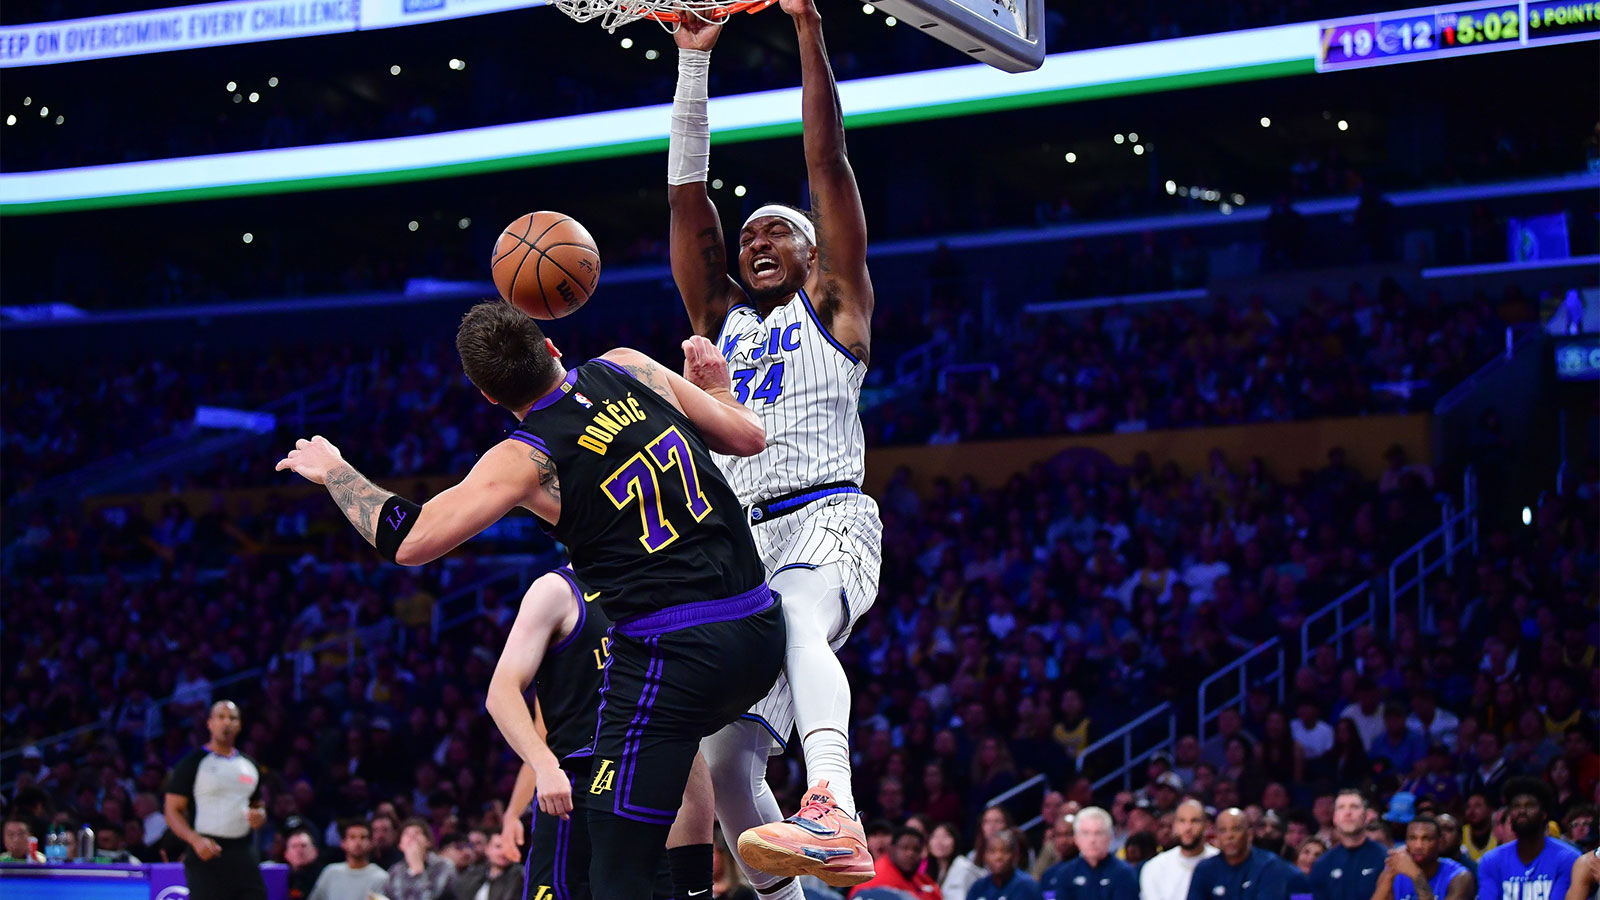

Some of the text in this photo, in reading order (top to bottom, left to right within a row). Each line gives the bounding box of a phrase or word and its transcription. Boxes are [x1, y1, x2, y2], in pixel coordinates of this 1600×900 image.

[35, 29, 60, 56] ON
[65, 15, 183, 53] OVERCOMING
[188, 10, 247, 39] EVERY
[1398, 20, 1433, 51] 12
[1457, 9, 1519, 44] 5:02
[1529, 9, 1541, 28] 3
[1338, 28, 1373, 58] 19
[732, 360, 785, 405] 34
[577, 391, 647, 456] DONČIĆ
[600, 424, 713, 554] 77
[386, 505, 407, 531] 77
[589, 759, 615, 795] LA
